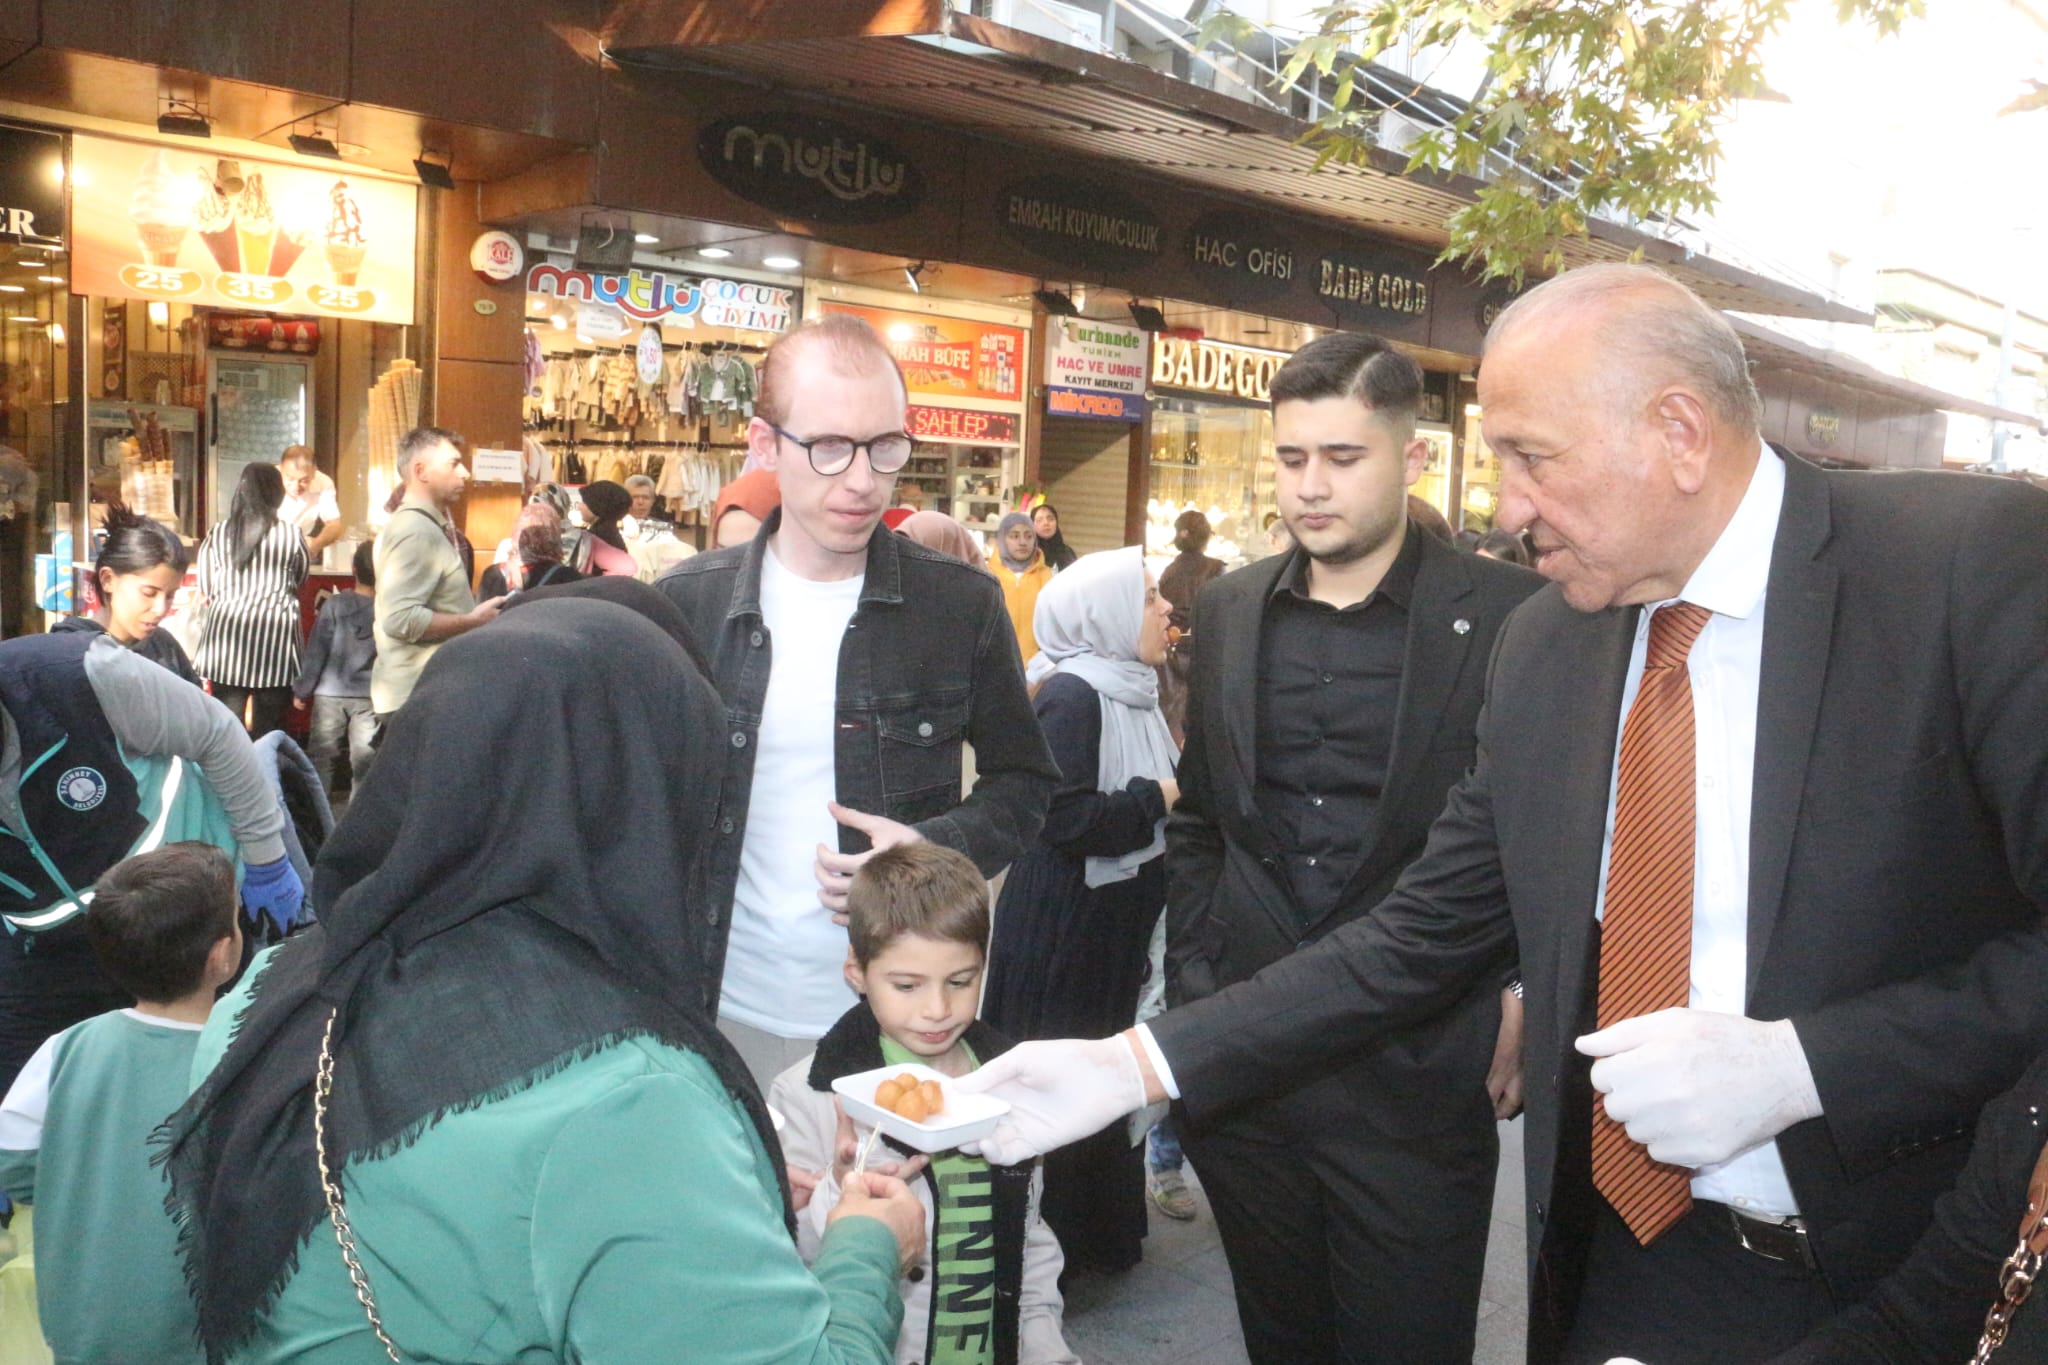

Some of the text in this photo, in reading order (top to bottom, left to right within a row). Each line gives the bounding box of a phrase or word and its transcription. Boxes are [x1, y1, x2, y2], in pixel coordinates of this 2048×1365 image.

[724, 126, 904, 200] mutlu
[1008, 196, 1160, 252] EMRAH KUYUMCULUK
[1195, 236, 1292, 279] HAC OFİSİ
[135, 271, 183, 291] 25
[228, 277, 275, 300] 35
[528, 264, 701, 319] mutlu
[703, 280, 793, 307] ÇOCUK
[1319, 259, 1427, 315] BADE GOLD
[317, 288, 360, 308] 25
[1063, 321, 1140, 349] urbande
[1057, 356, 1143, 379] HAC VE UMRE
[1064, 374, 1134, 392] KAYIT MERKEZİ
[915, 410, 988, 436] SAHLEP
